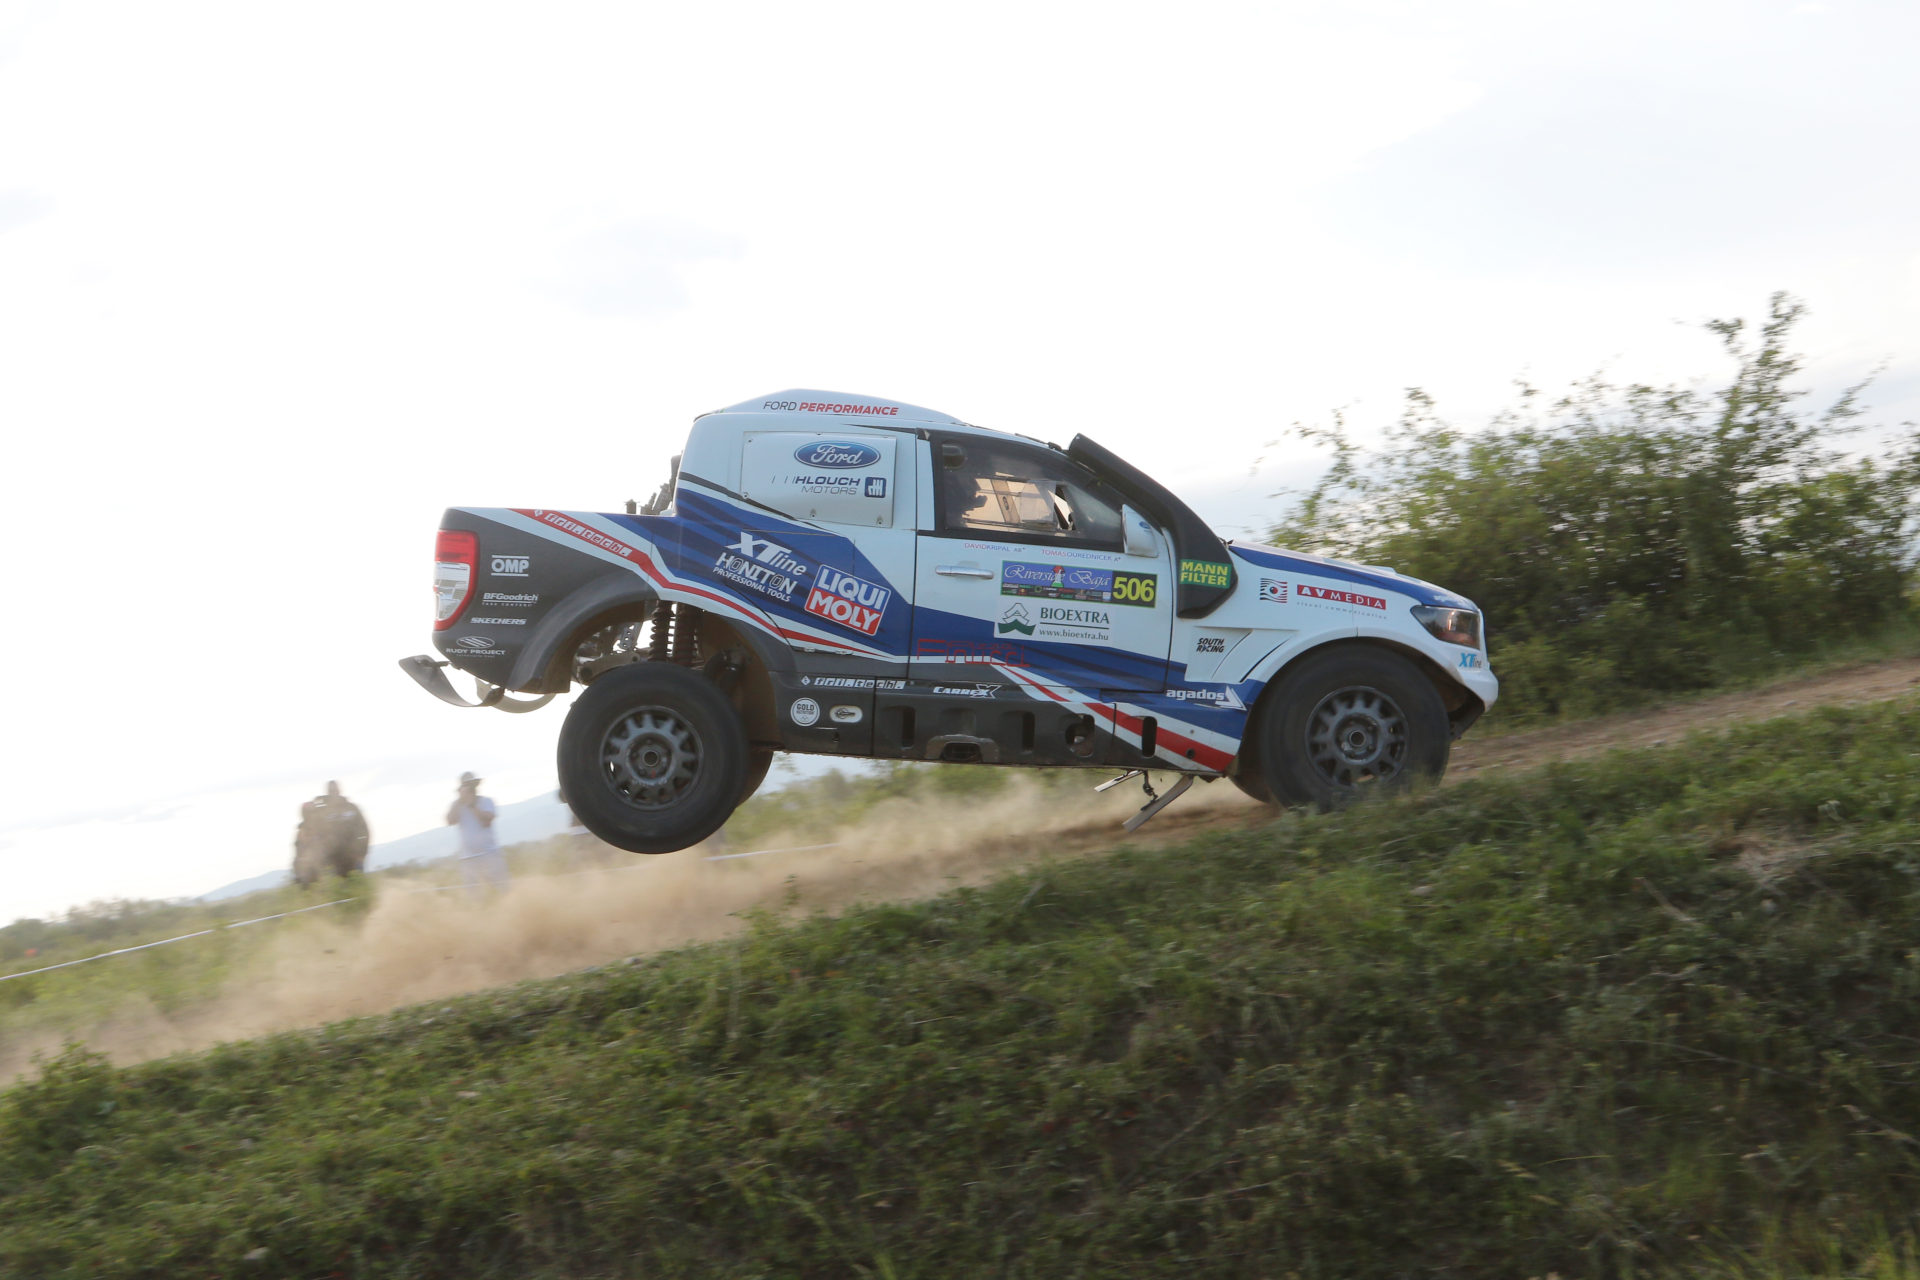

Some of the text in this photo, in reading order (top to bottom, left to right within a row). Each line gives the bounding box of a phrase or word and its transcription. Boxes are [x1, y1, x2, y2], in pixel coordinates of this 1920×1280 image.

[763, 401, 899, 416] FORD PERFORMANCE
[810, 443, 863, 465] Ford
[795, 476, 861, 487] HLOUCH
[801, 486, 858, 495] MOTORS
[491, 559, 530, 574] OMP
[715, 552, 798, 595] HONITON
[1181, 561, 1228, 576] MANN
[712, 566, 792, 602] PROFESSIONAL TOOLS
[1181, 572, 1227, 587] FILTER
[483, 592, 539, 601] BFGoodrich
[817, 568, 887, 610] LIQUI
[1112, 576, 1155, 602] 506
[809, 590, 881, 631] MOLY
[1039, 607, 1110, 624] BIOEXTRA
[470, 617, 527, 625] SKECHERS
[1039, 629, 1109, 641] www.bioextra.hu
[1197, 637, 1224, 645] SOUTH
[1166, 688, 1225, 702] agados
